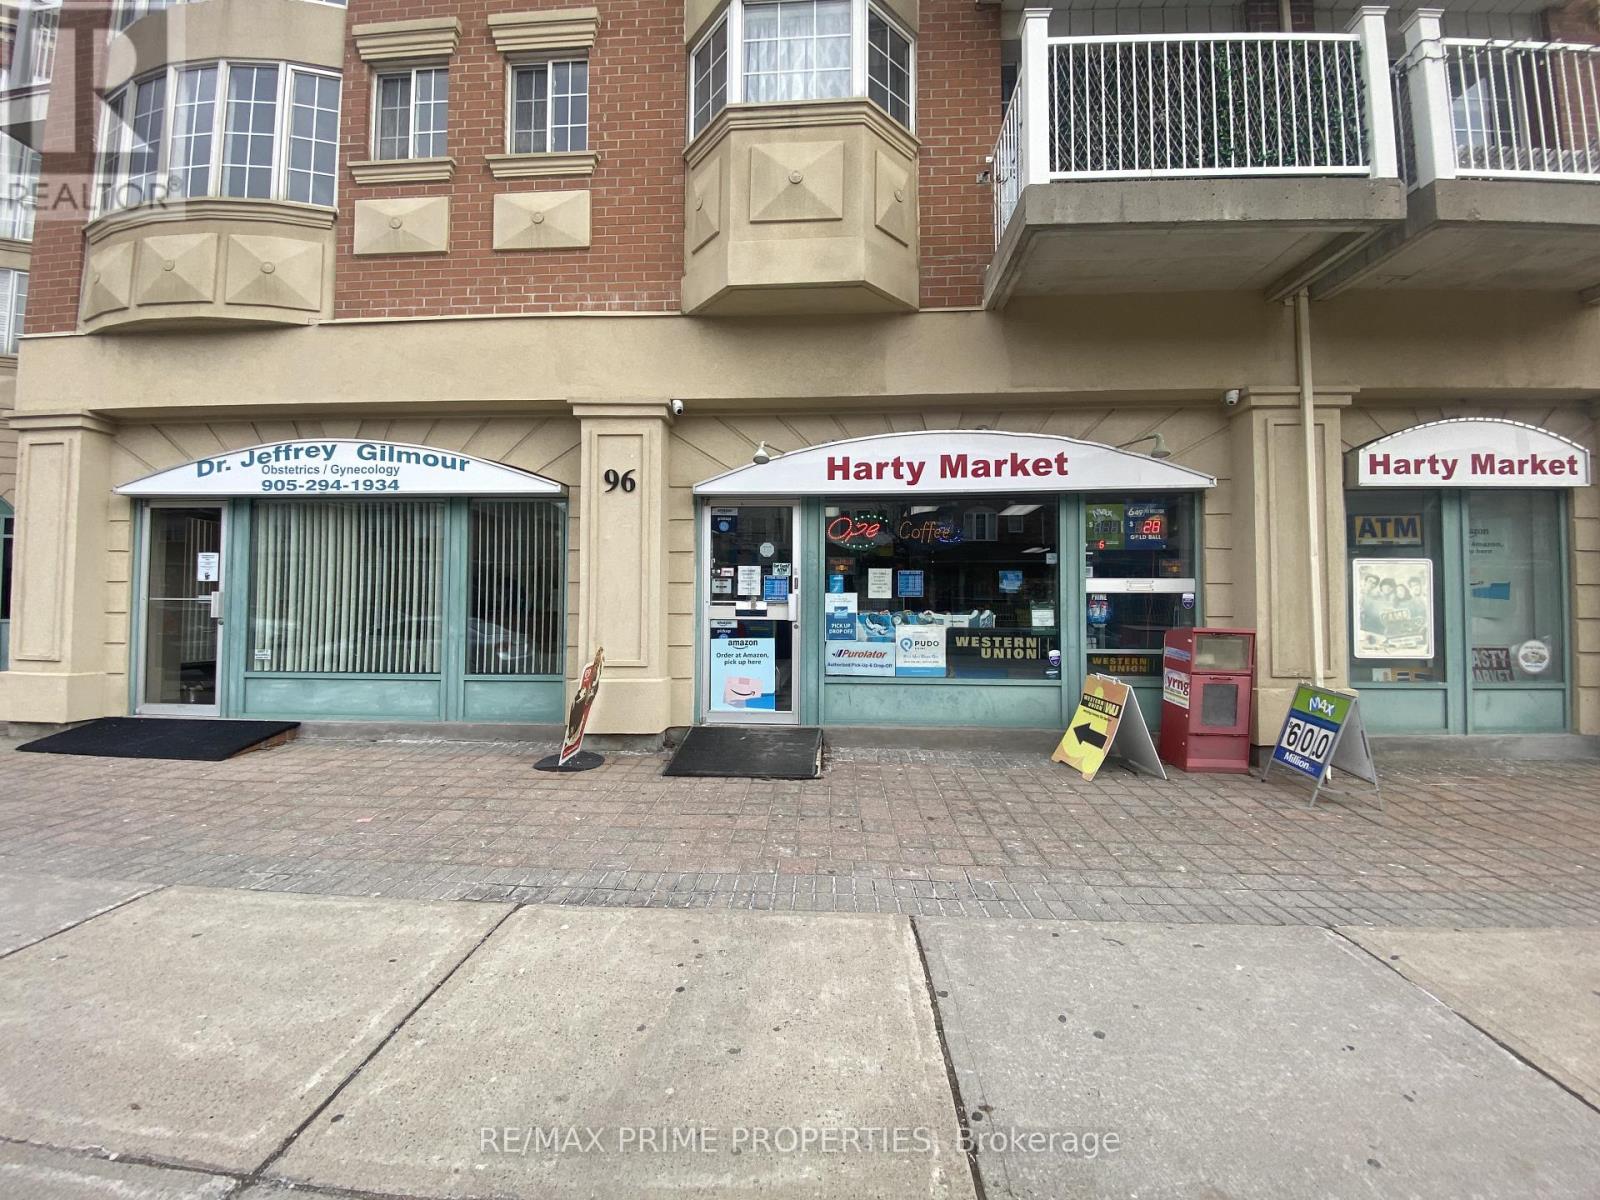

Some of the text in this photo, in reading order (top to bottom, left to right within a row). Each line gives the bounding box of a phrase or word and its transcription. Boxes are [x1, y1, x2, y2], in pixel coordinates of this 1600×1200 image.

[197, 443, 470, 478] Dr. Jeffrey Gilmour
[827, 451, 1069, 486] Harty Market
[1369, 453, 1579, 480] Harty Market
[261, 464, 320, 475] Obstetrics
[330, 464, 400, 476] Gynecology
[261, 479, 400, 492] 905-294-1934
[604, 468, 636, 493] 96
[1143, 520, 1161, 534] 28
[1358, 518, 1418, 539] ATM
[955, 636, 1037, 648] WESTERN
[843, 649, 887, 659] Purolator
[981, 648, 1037, 659] UNION
[1092, 657, 1148, 666] WESTERN
[1167, 676, 1190, 697] yrng
[1309, 696, 1335, 716] MAX
[1284, 752, 1309, 770] Million
